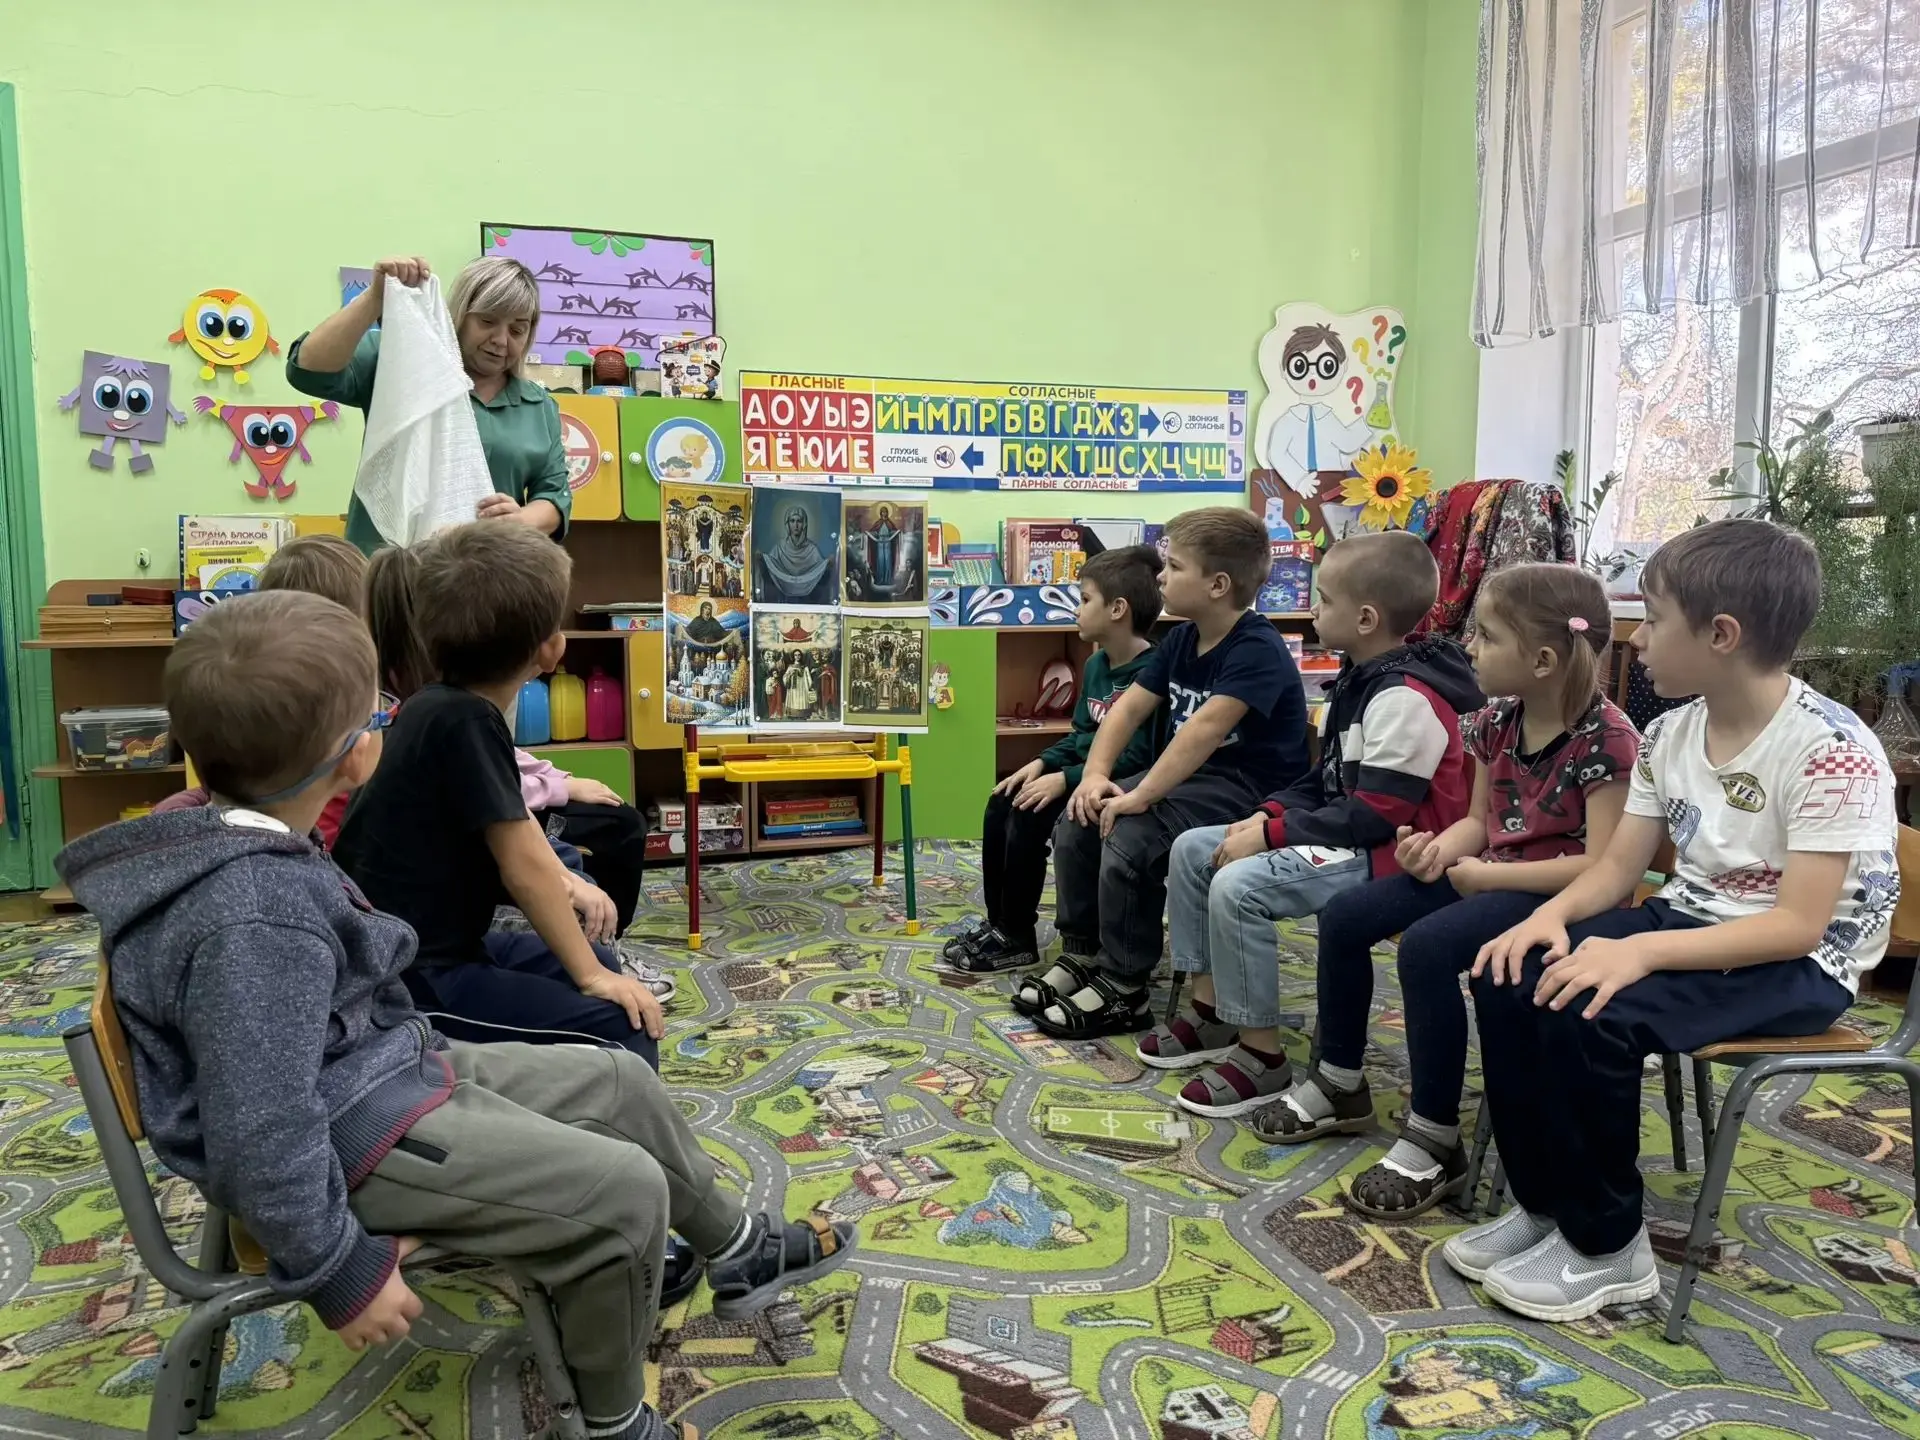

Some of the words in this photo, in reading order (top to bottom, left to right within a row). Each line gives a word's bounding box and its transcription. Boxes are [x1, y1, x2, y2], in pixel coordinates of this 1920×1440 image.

[770, 374, 846, 390] ГЛАСНЫЕ
[1008, 385, 1096, 399] СОГЛАСНЫЕ
[1187, 415, 1219, 423] ЗВОНКИЕ
[1184, 422, 1225, 430] СОГЛАСНЫЕ
[889, 447, 919, 456] ГЛУХИЕ
[881, 455, 928, 464] СОГЛАСНЫЕ
[1011, 479, 1057, 489] ПАРНЫЕ
[1063, 480, 1128, 490] СОГЛАСНЫЕ
[190, 530, 227, 540] СТРАНА
[230, 531, 268, 540] БЛОКОВ
[1270, 544, 1294, 555] STEM
[1796, 776, 1878, 819] 54
